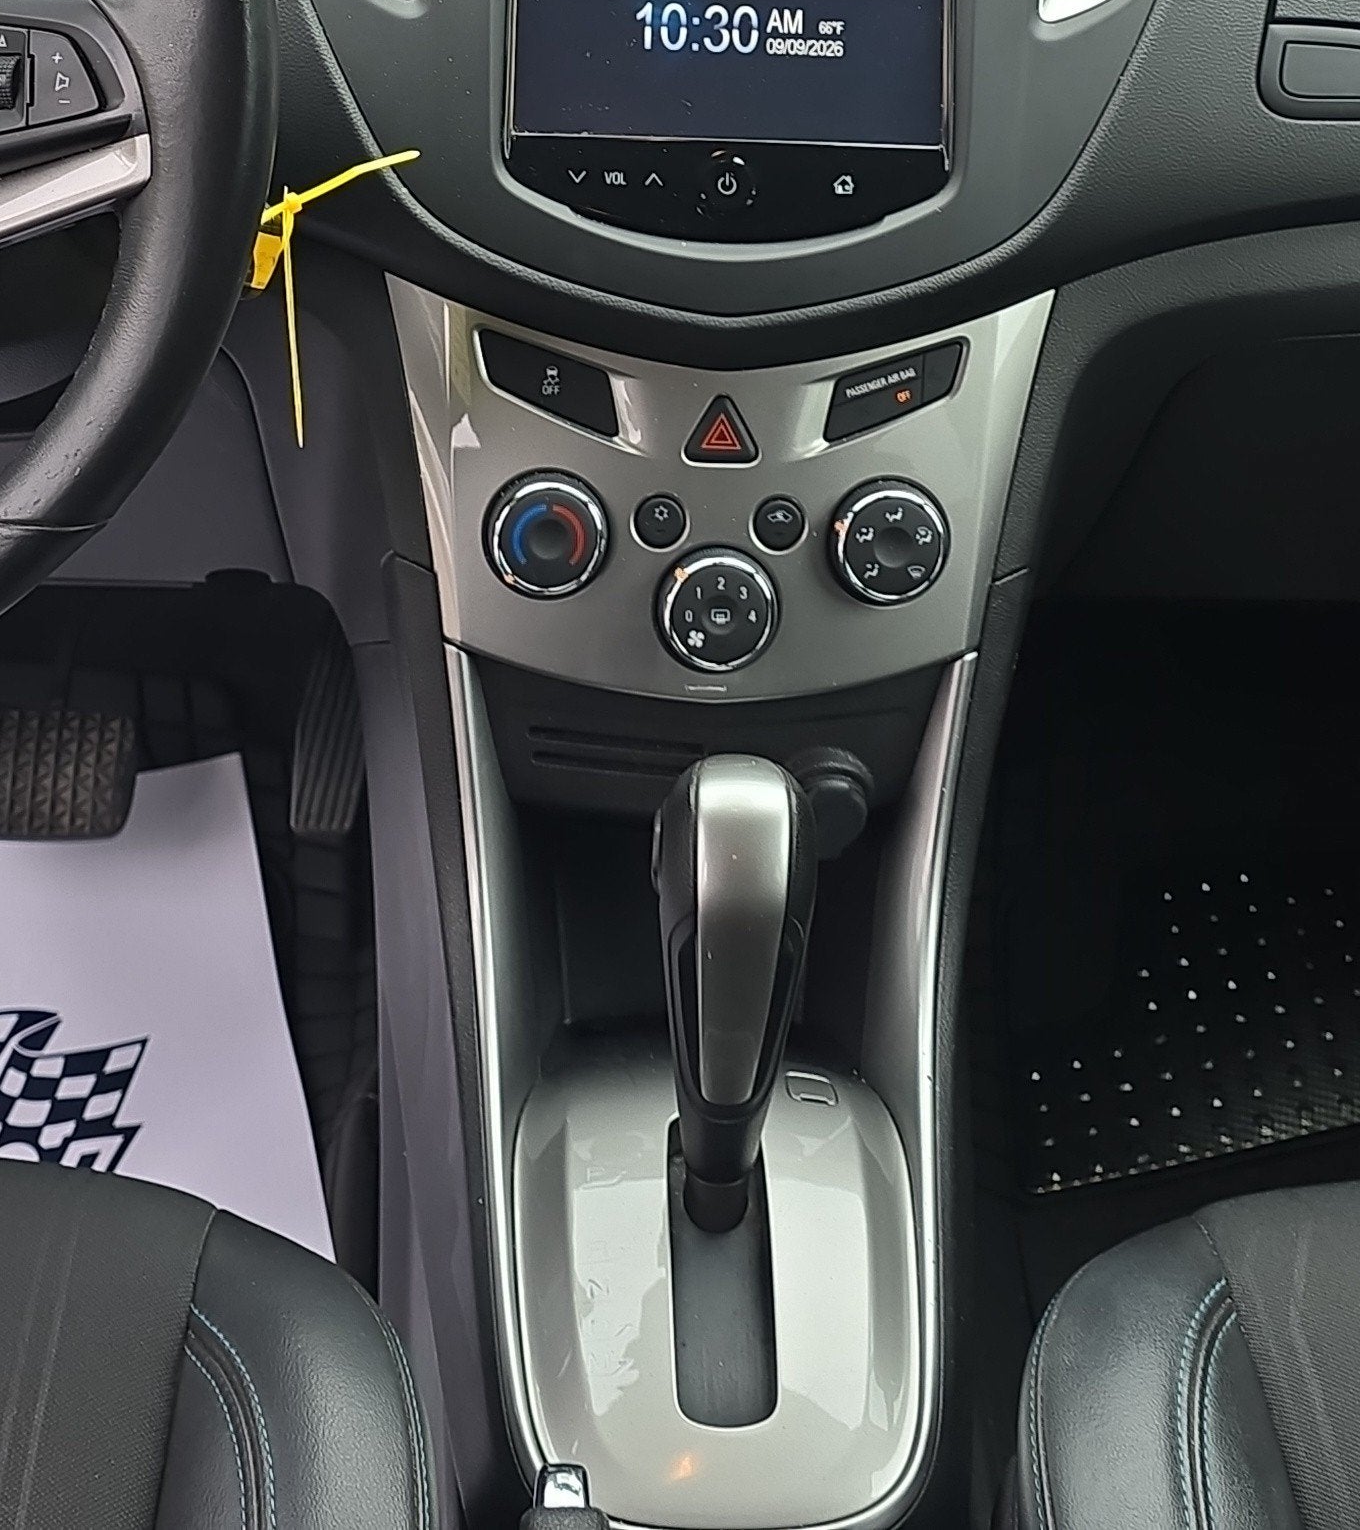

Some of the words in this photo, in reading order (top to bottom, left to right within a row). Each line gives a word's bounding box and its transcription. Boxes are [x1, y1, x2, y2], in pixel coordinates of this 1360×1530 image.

[636, 1, 759, 53] 10:30
[766, 8, 804, 34] AM
[766, 37, 844, 57] 09/09/2026
[604, 171, 627, 185] VOL
[542, 384, 560, 395] OFF
[845, 377, 888, 398] PASSENGER
[897, 390, 911, 402] OFF
[717, 576, 726, 590] 2
[696, 586, 702, 600] 1
[740, 586, 748, 600] 3
[685, 609, 693, 622] 0
[748, 609, 757, 623] 4
